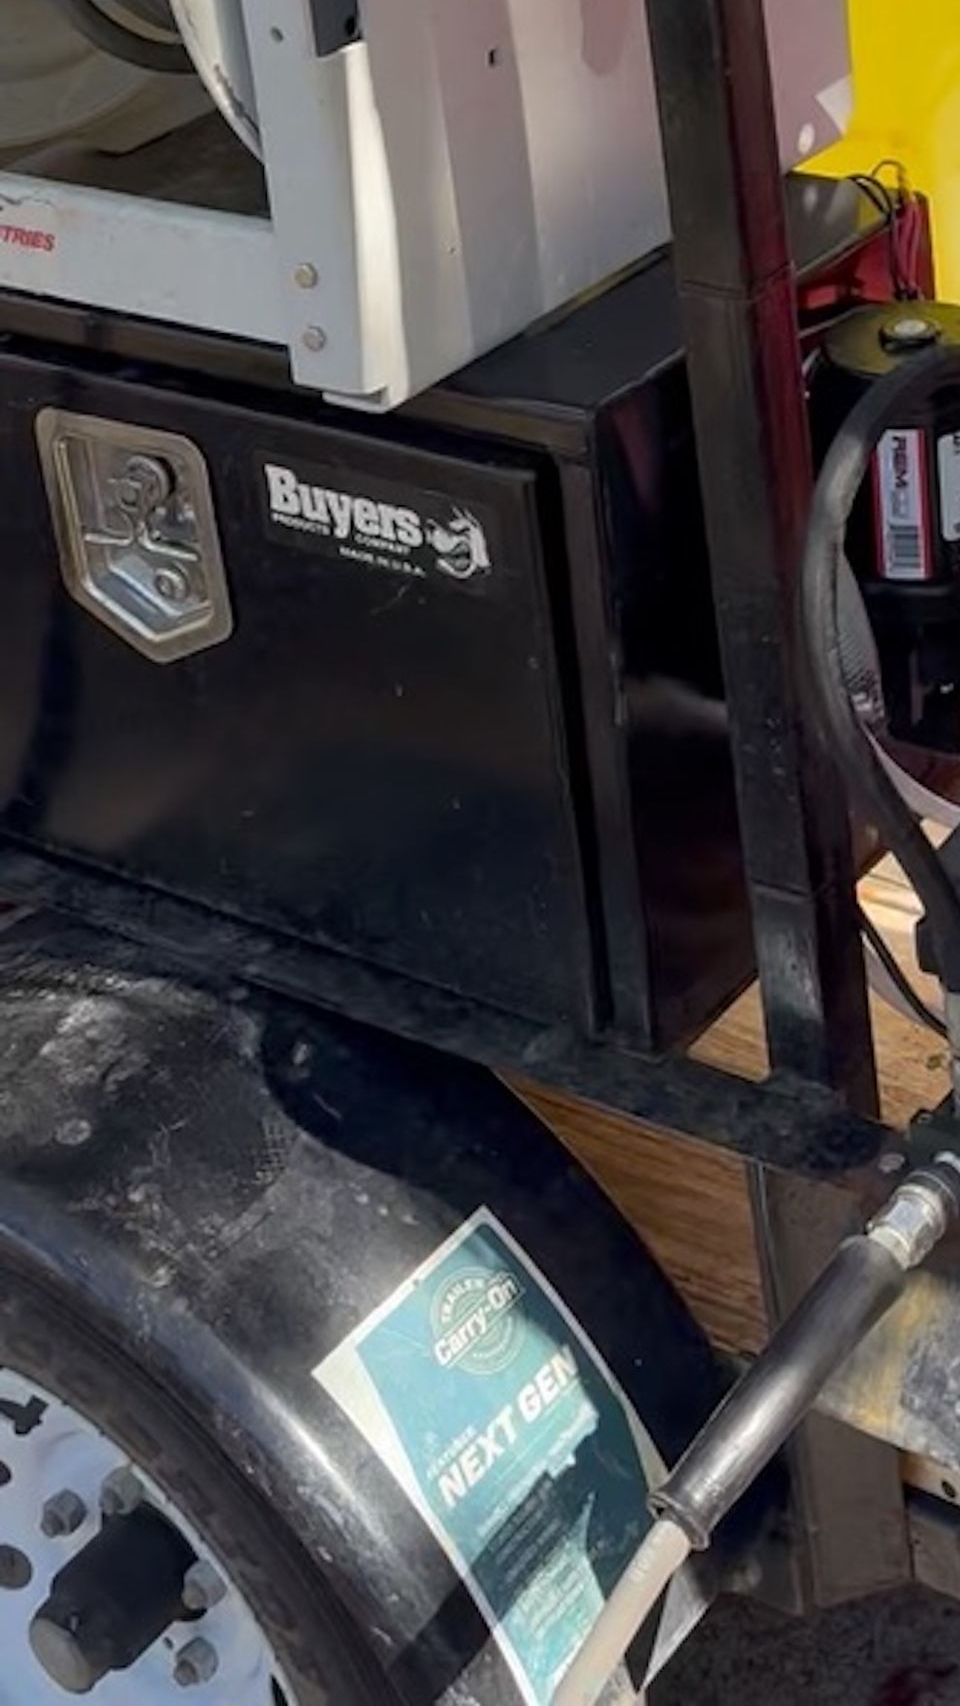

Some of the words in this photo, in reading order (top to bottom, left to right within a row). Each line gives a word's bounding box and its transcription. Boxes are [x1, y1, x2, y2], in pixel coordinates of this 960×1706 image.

[264, 463, 424, 548] Buyers
[434, 1278, 519, 1365] Carry-On
[437, 1403, 517, 1508] NEXT
[517, 1344, 579, 1423] GEN
